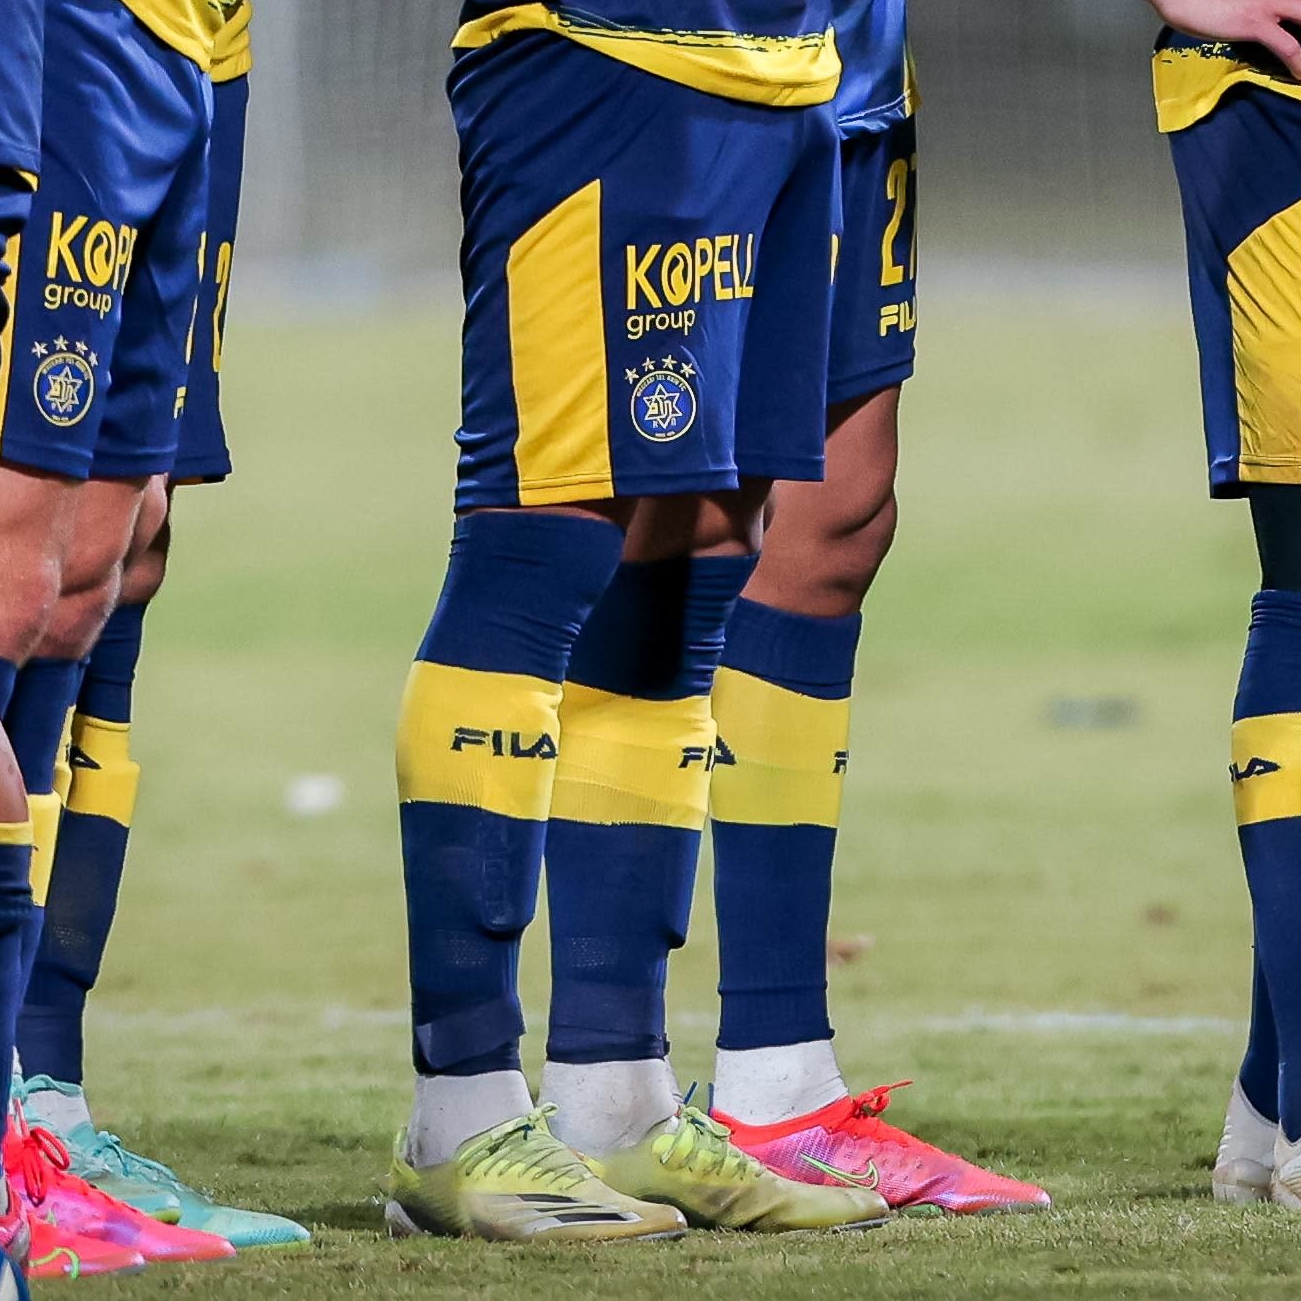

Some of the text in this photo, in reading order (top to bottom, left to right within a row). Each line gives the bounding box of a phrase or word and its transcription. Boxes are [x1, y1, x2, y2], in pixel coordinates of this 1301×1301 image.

[626, 233, 754, 310] KOPELL
[44, 283, 112, 320] group
[626, 309, 696, 340] group
[450, 726, 559, 761] FILA
